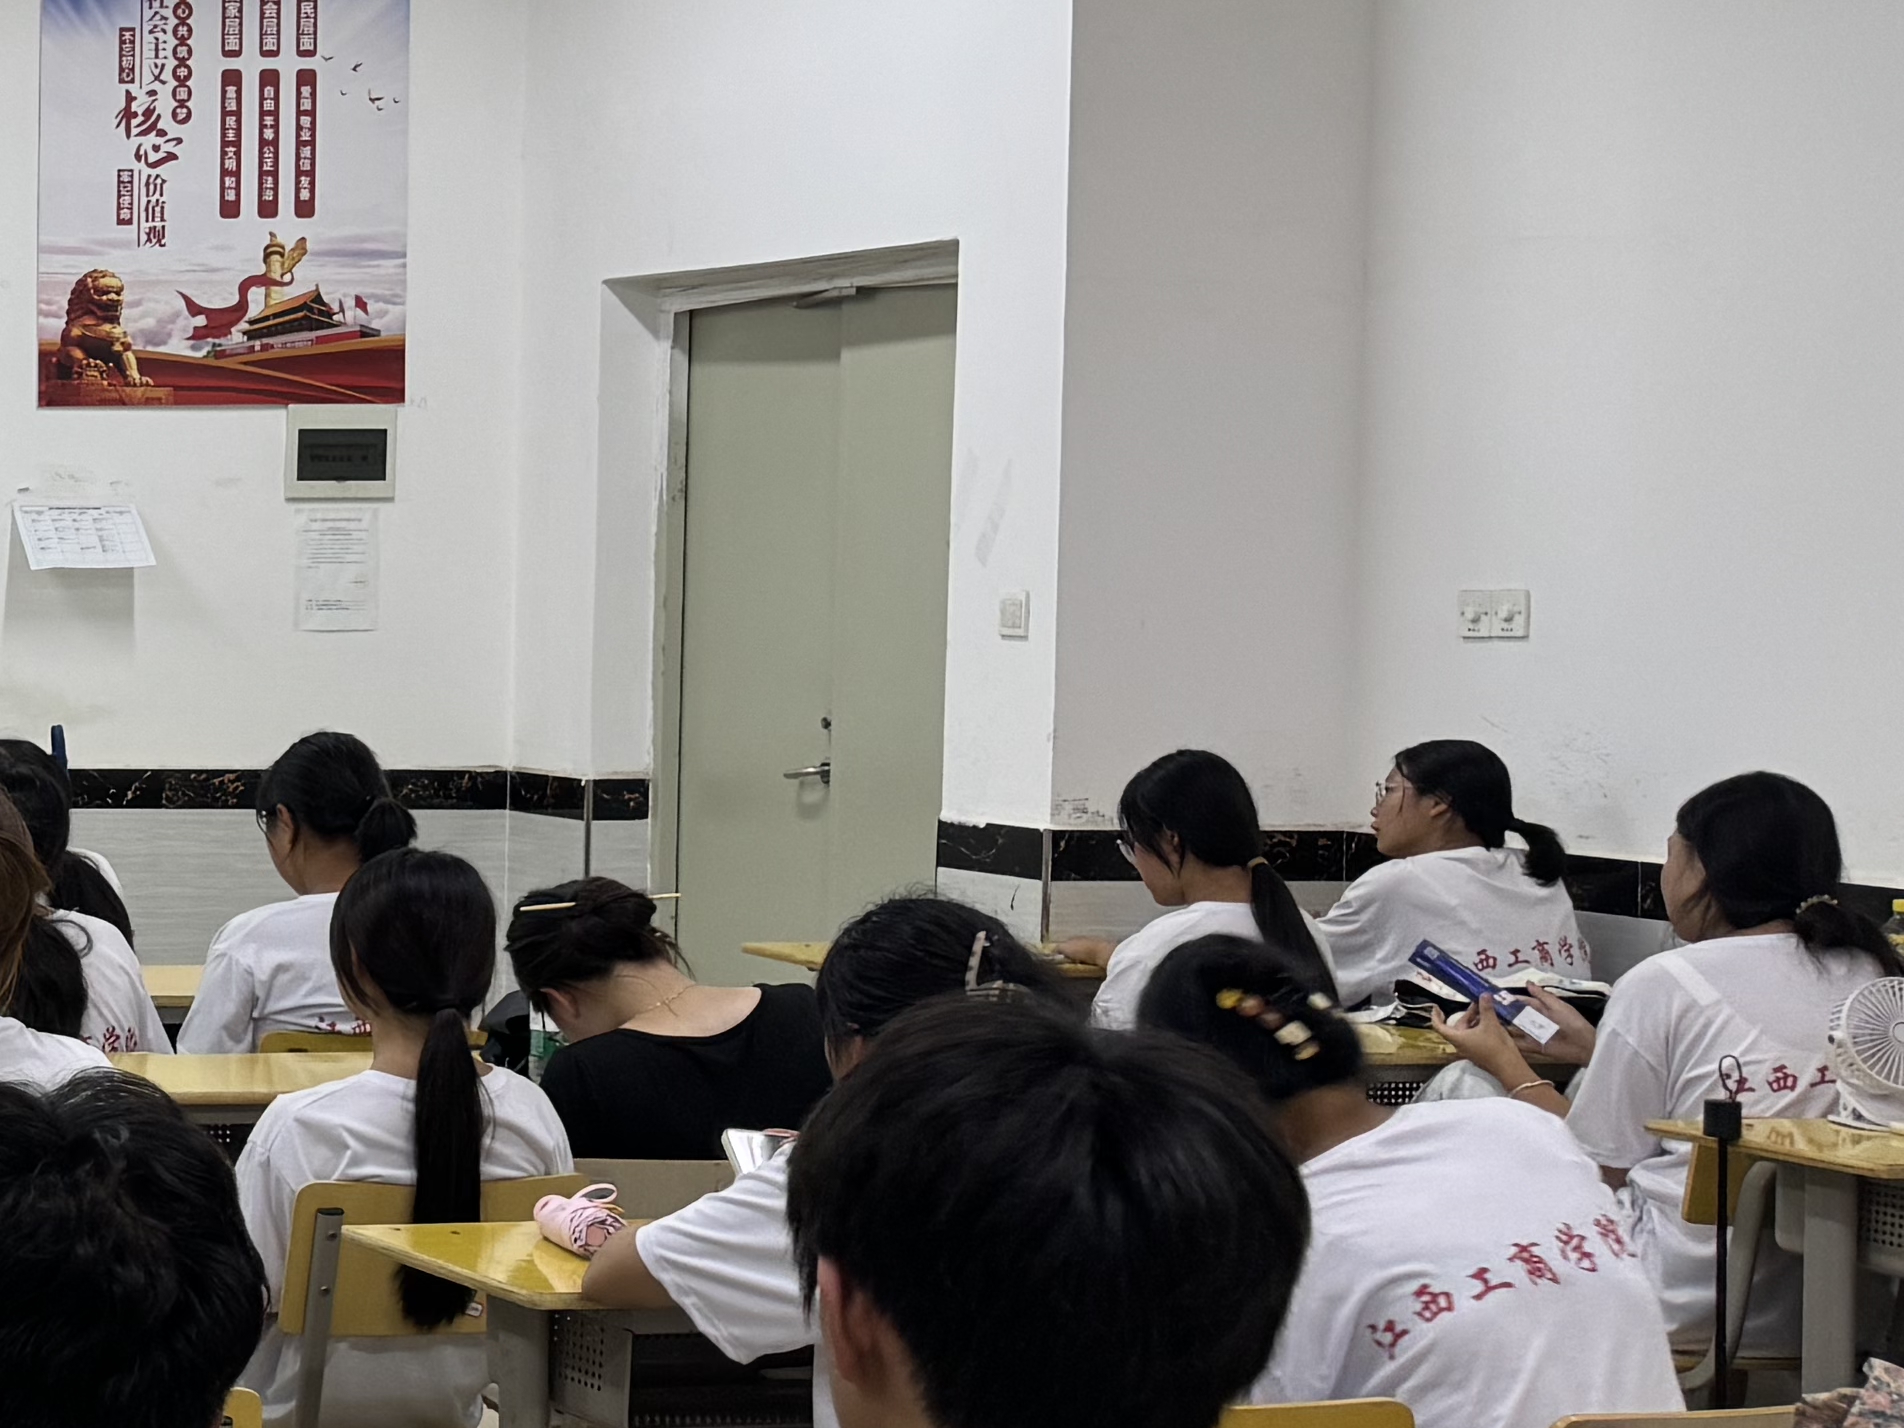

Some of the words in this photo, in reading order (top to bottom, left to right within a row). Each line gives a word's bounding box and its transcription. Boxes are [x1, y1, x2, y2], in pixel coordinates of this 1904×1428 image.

[1366, 1214, 1638, 1361] 江西工商学院
